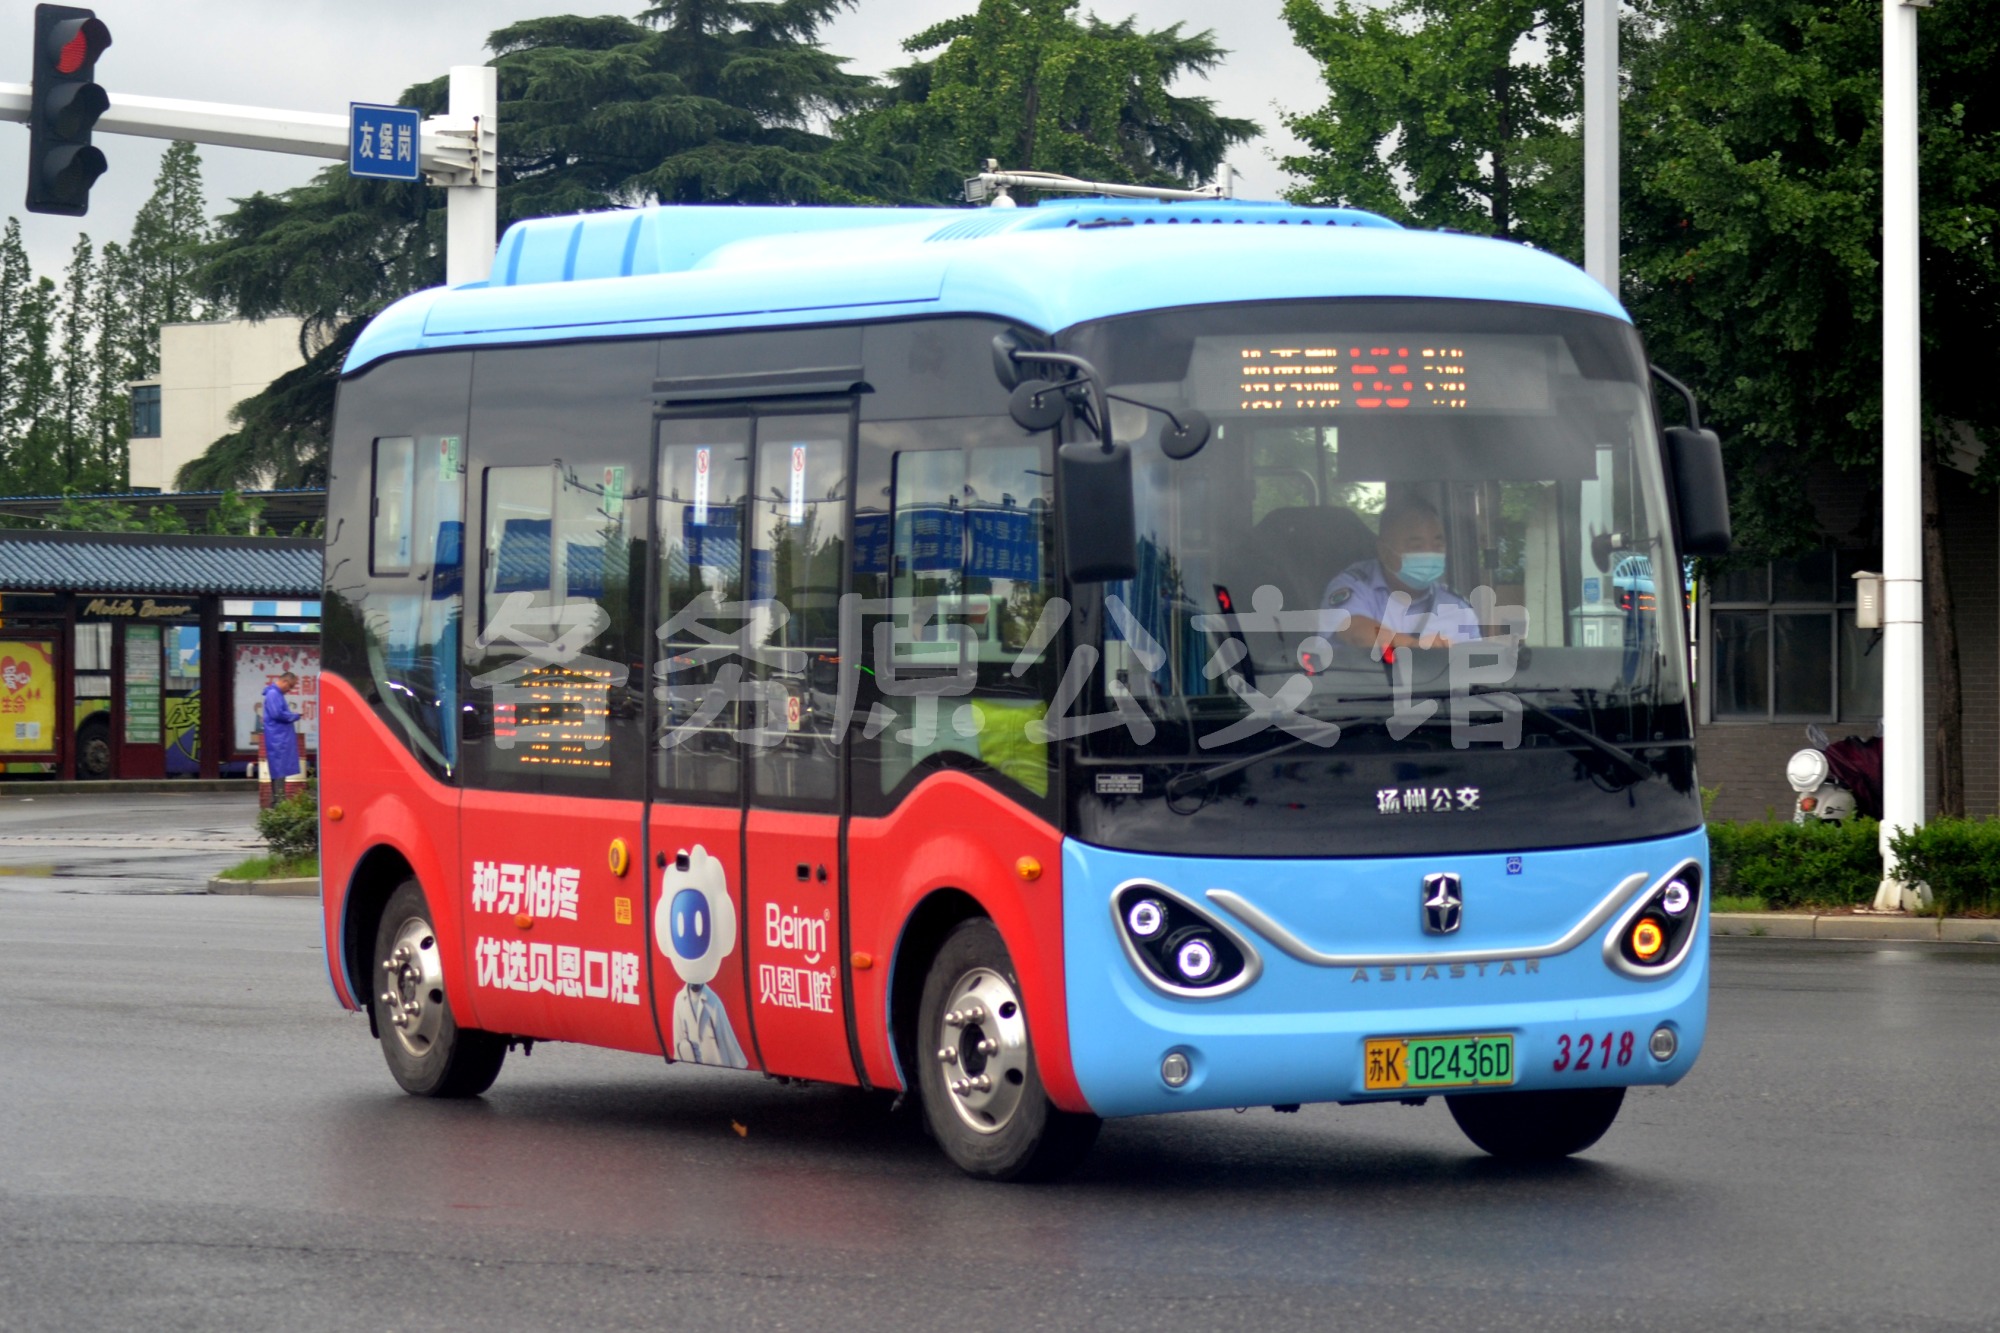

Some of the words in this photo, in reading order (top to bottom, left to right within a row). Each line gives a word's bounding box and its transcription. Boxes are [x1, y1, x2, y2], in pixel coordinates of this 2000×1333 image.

[359, 121, 411, 162] 友堡岗
[1377, 787, 1480, 814] 扬州公交
[472, 861, 581, 920] 种牙怕疼
[475, 936, 640, 1005] 优选贝恩口腔
[759, 964, 834, 1013] 贝恩口腔
[1351, 957, 1541, 983] ASIASTAR
[1553, 1030, 1635, 1072] 3218
